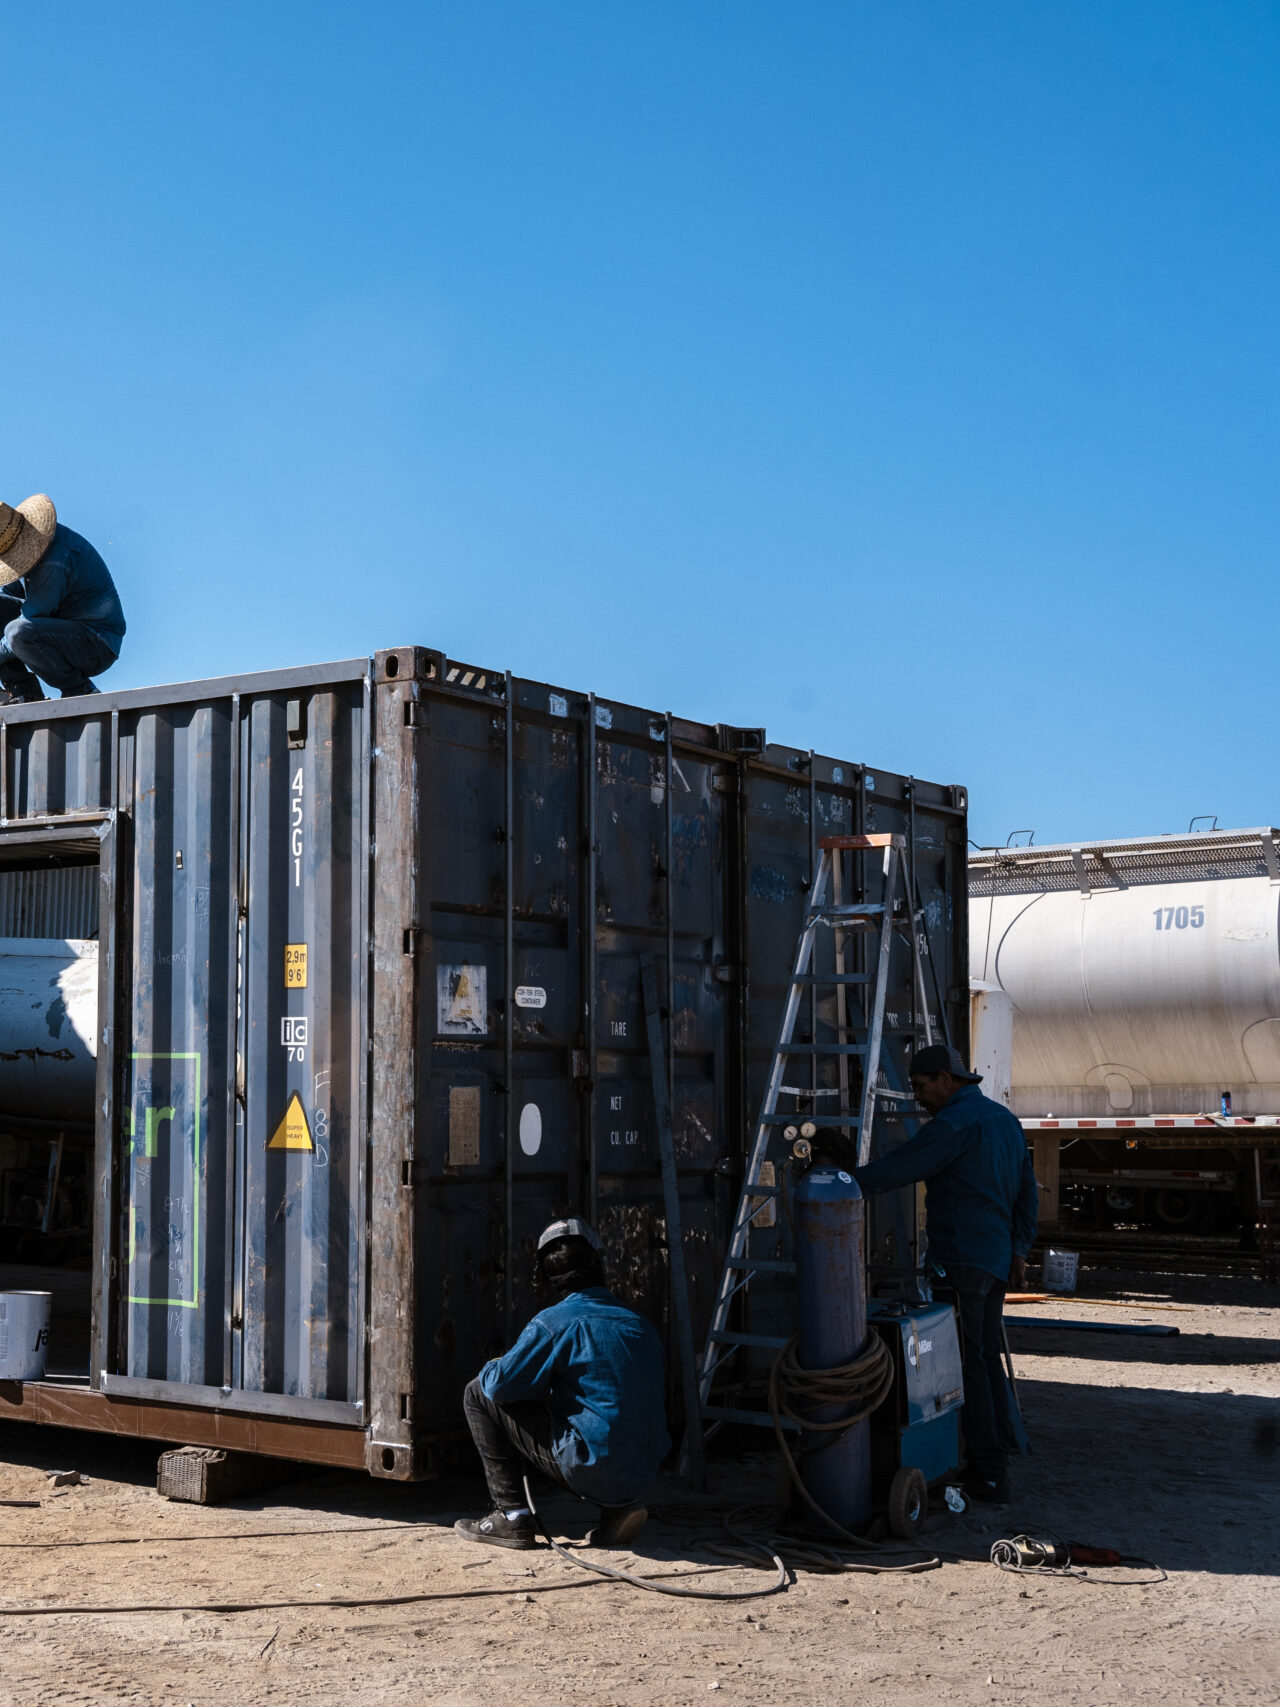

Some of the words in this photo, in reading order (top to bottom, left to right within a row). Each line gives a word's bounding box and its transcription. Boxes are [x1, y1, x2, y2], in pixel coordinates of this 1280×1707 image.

[291, 767, 304, 887] 45G1
[1153, 905, 1205, 931] 1705
[521, 997, 541, 1005] CONTAINER
[610, 1021, 627, 1037] TARE
[287, 1047, 305, 1062] 70
[610, 1095, 623, 1111] NET
[287, 1132, 304, 1140] HEAVY
